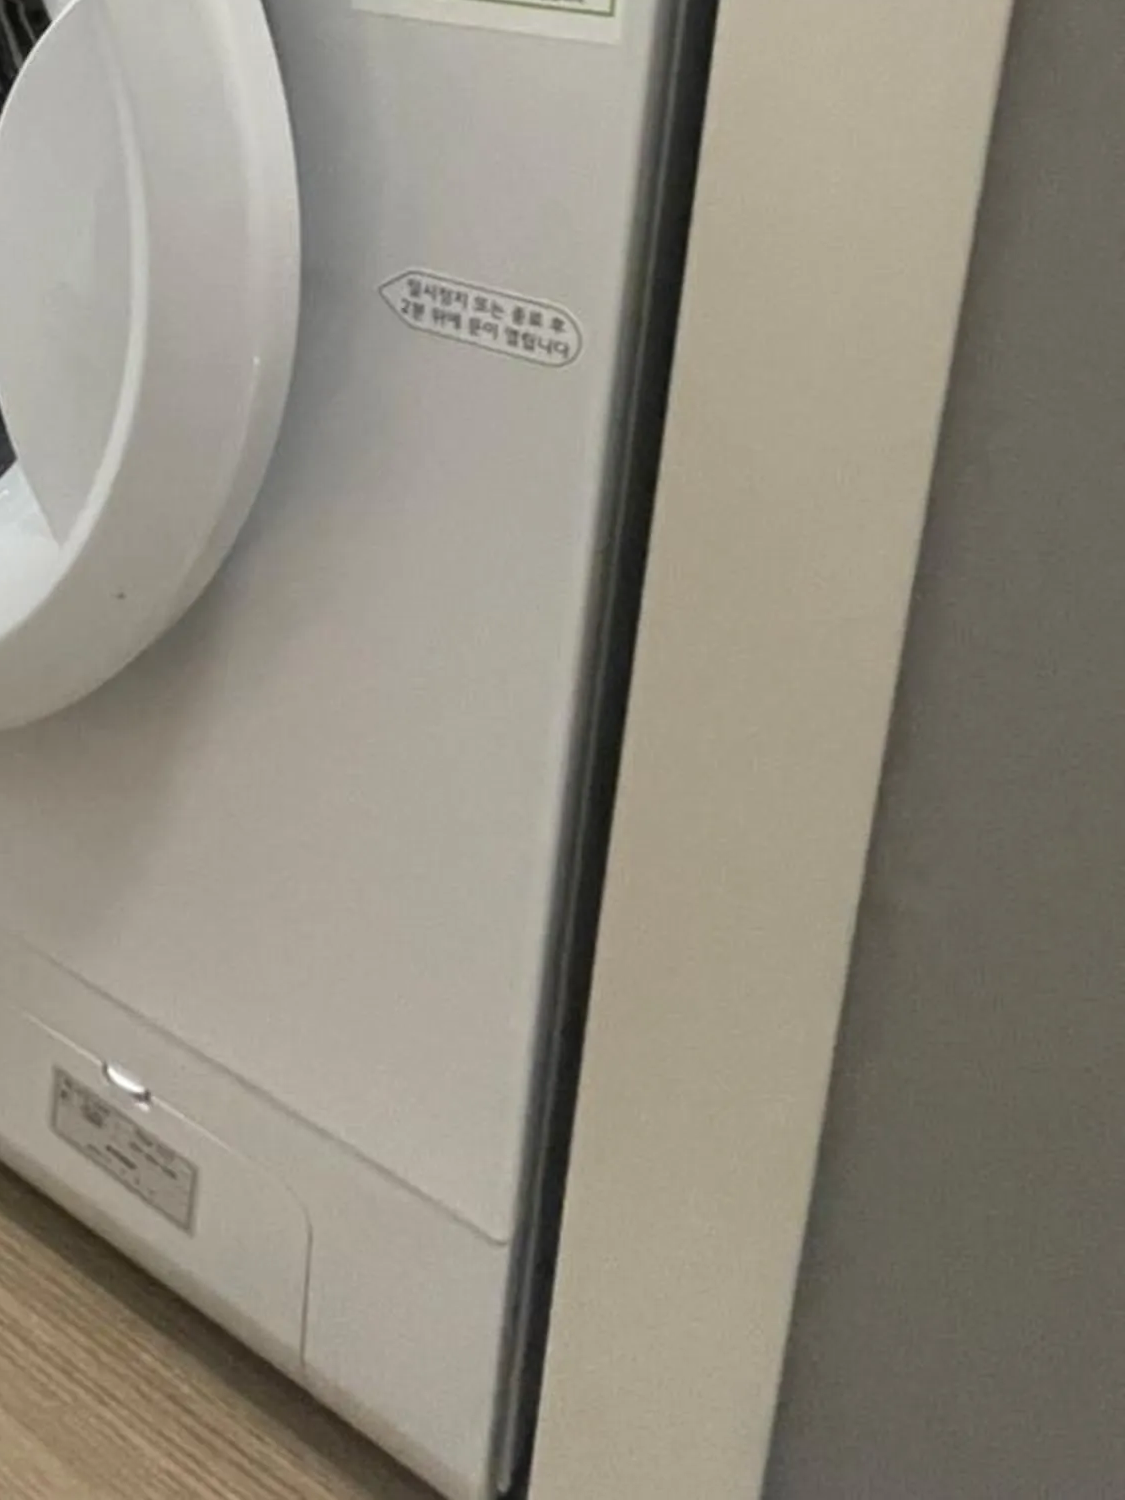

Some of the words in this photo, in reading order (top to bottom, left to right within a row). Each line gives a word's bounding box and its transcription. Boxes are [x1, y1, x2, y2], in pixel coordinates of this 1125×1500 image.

[401, 298, 426, 322] 2분
[469, 316, 500, 340] 문이
[505, 326, 570, 360] 열립니다
[407, 278, 469, 309] 일시정지
[473, 296, 505, 320] 또는
[512, 305, 544, 327] 종료
